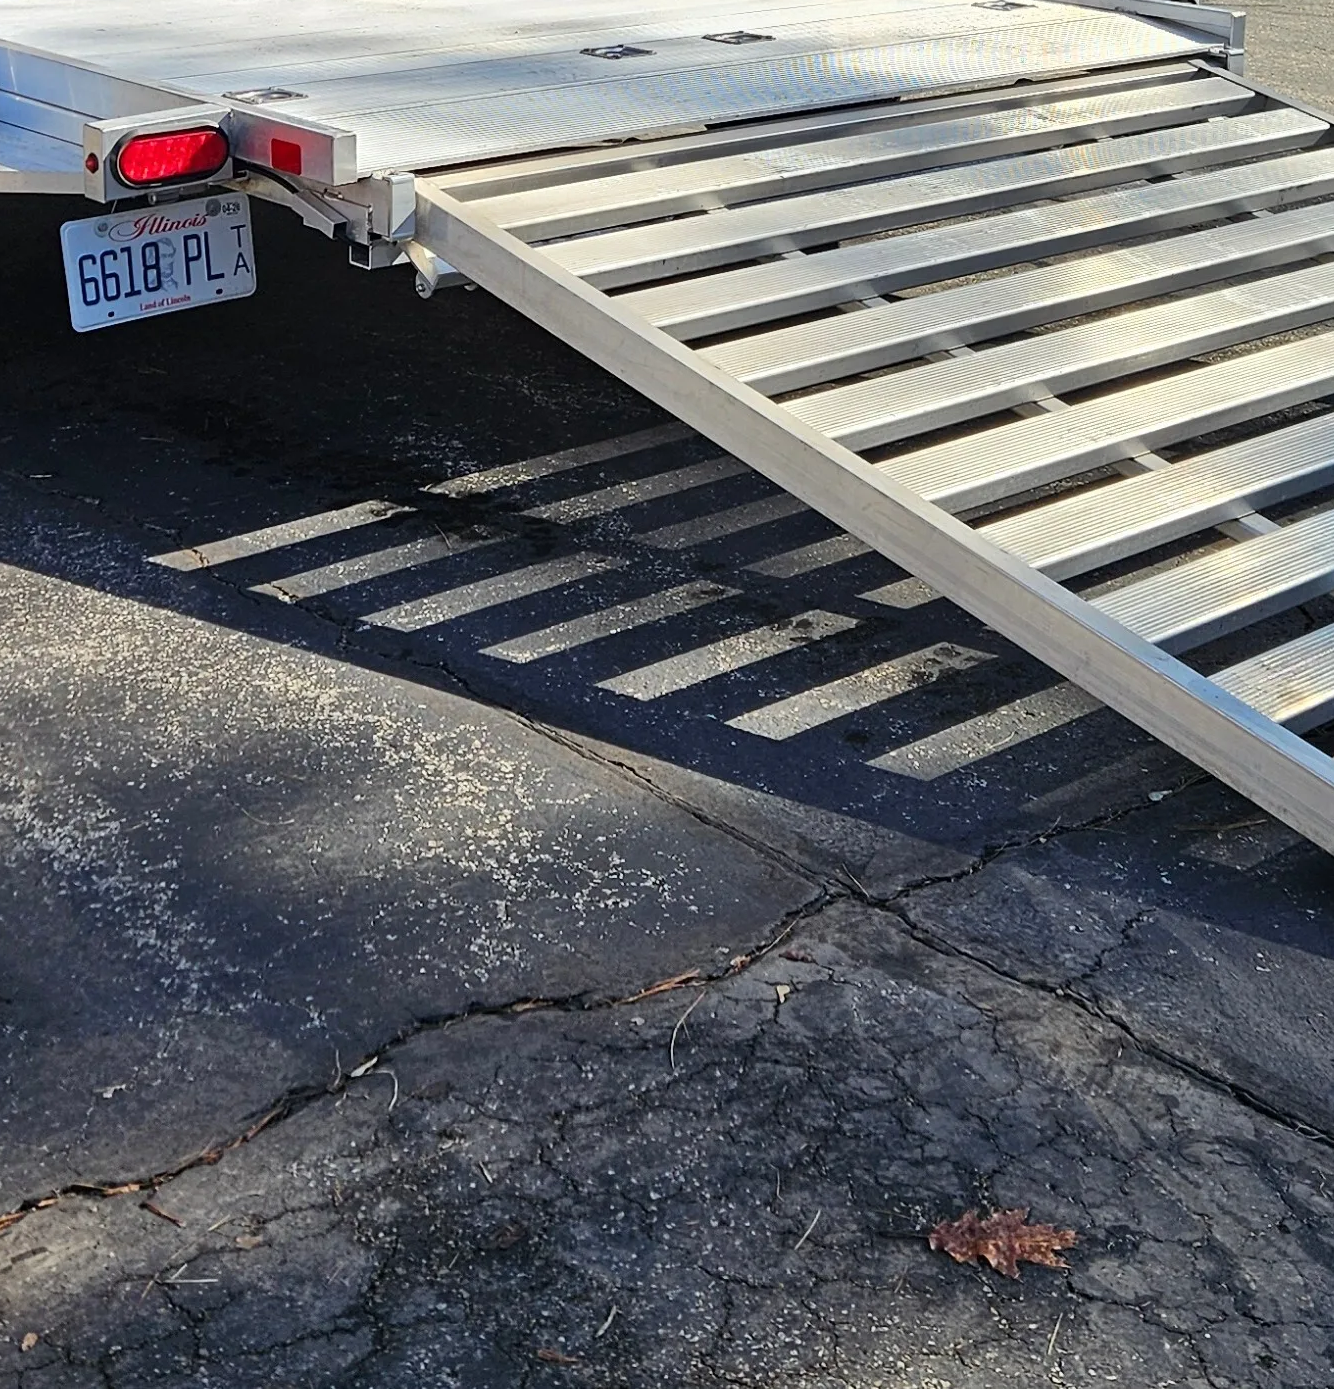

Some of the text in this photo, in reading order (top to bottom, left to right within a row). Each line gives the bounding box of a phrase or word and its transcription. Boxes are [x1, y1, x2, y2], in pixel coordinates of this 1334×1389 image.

[109, 212, 207, 242] Illinois
[78, 230, 225, 307] 6618 PL
[139, 299, 157, 311] Land
[166, 294, 191, 306] Lincoln
